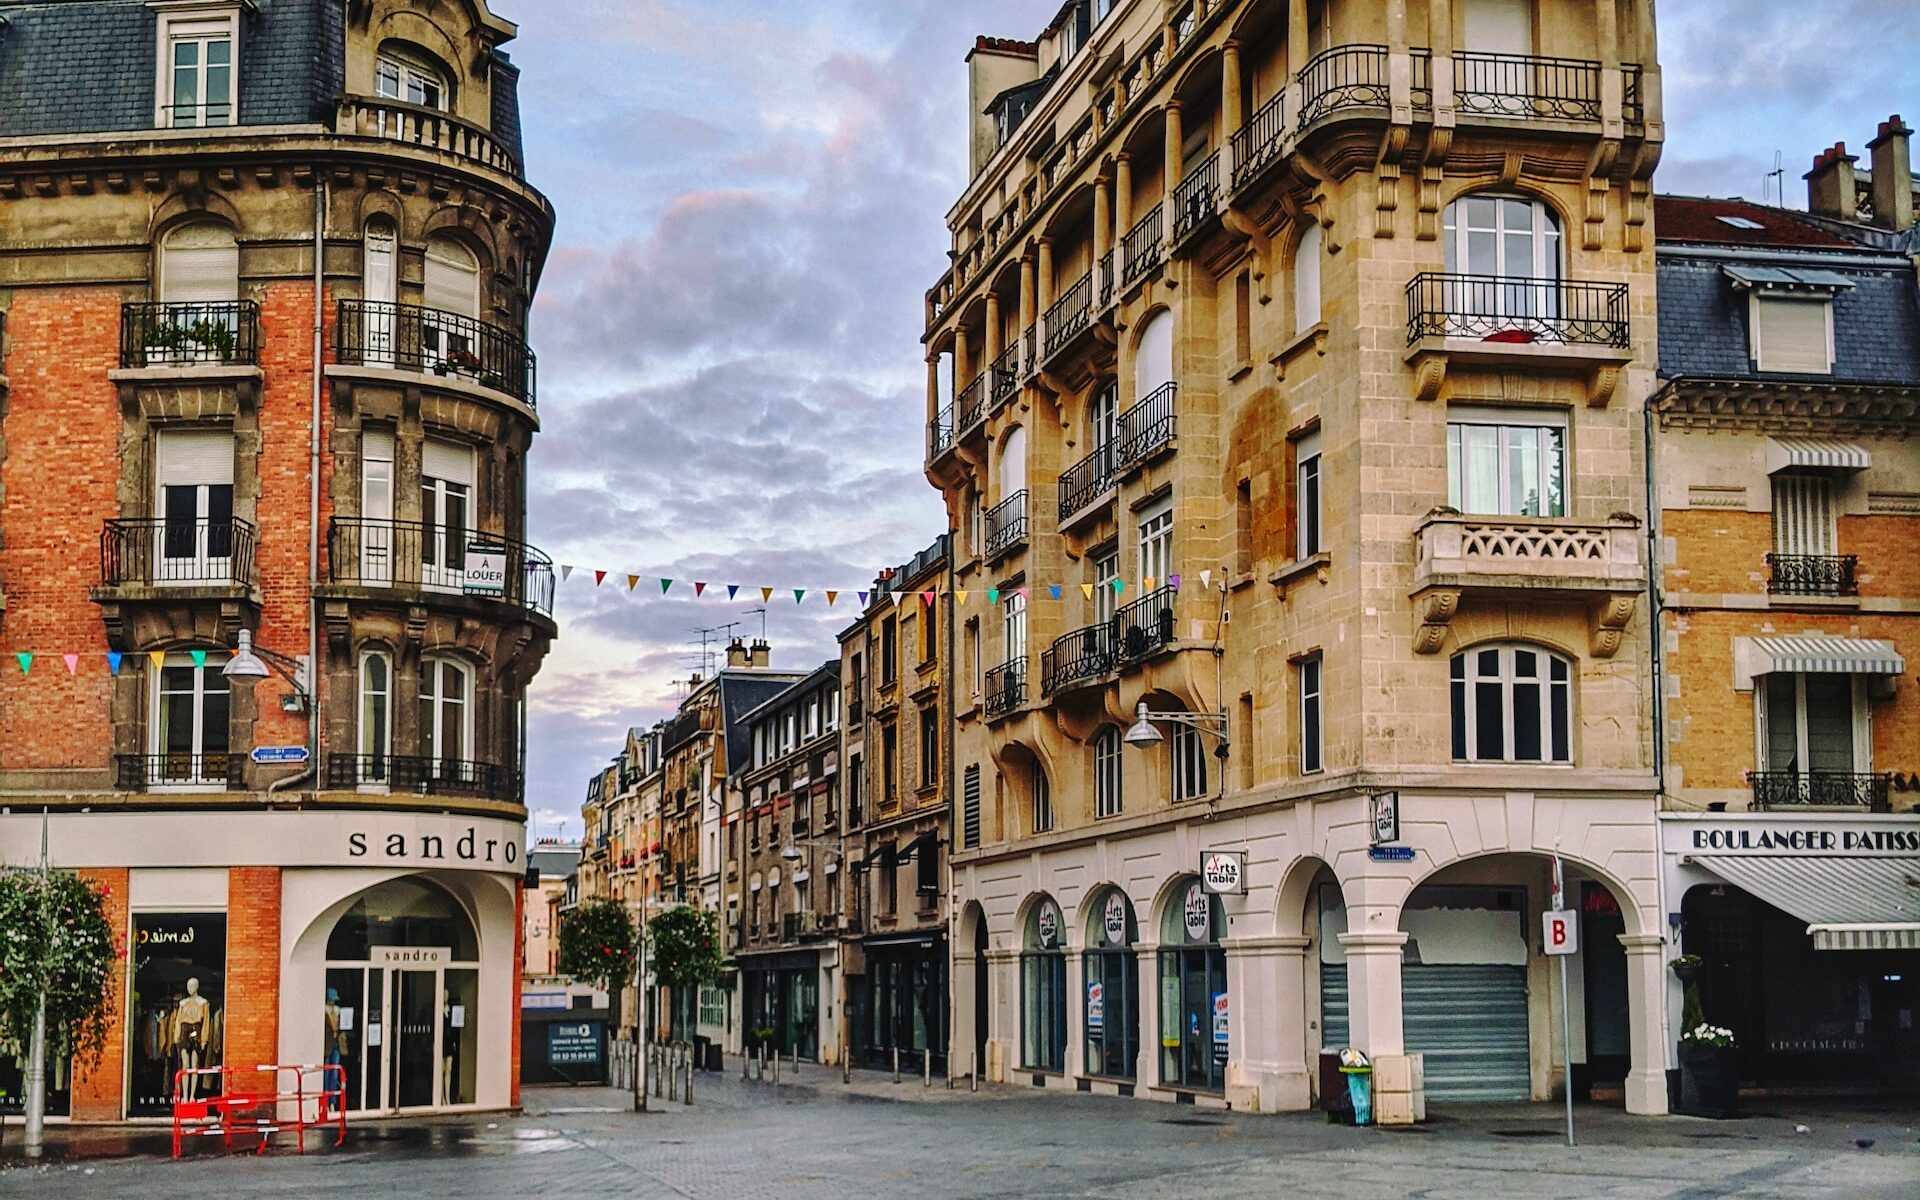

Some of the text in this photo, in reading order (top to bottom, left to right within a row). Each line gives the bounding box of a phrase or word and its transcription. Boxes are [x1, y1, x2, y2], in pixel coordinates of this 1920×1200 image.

[466, 570, 503, 581] LOUER
[349, 827, 517, 864] sandro
[1692, 830, 1920, 851] BOULANGER PATISS
[1207, 872, 1237, 883] Table
[1186, 911, 1206, 927] Table
[1552, 919, 1566, 946] B
[385, 949, 438, 961] sandro
